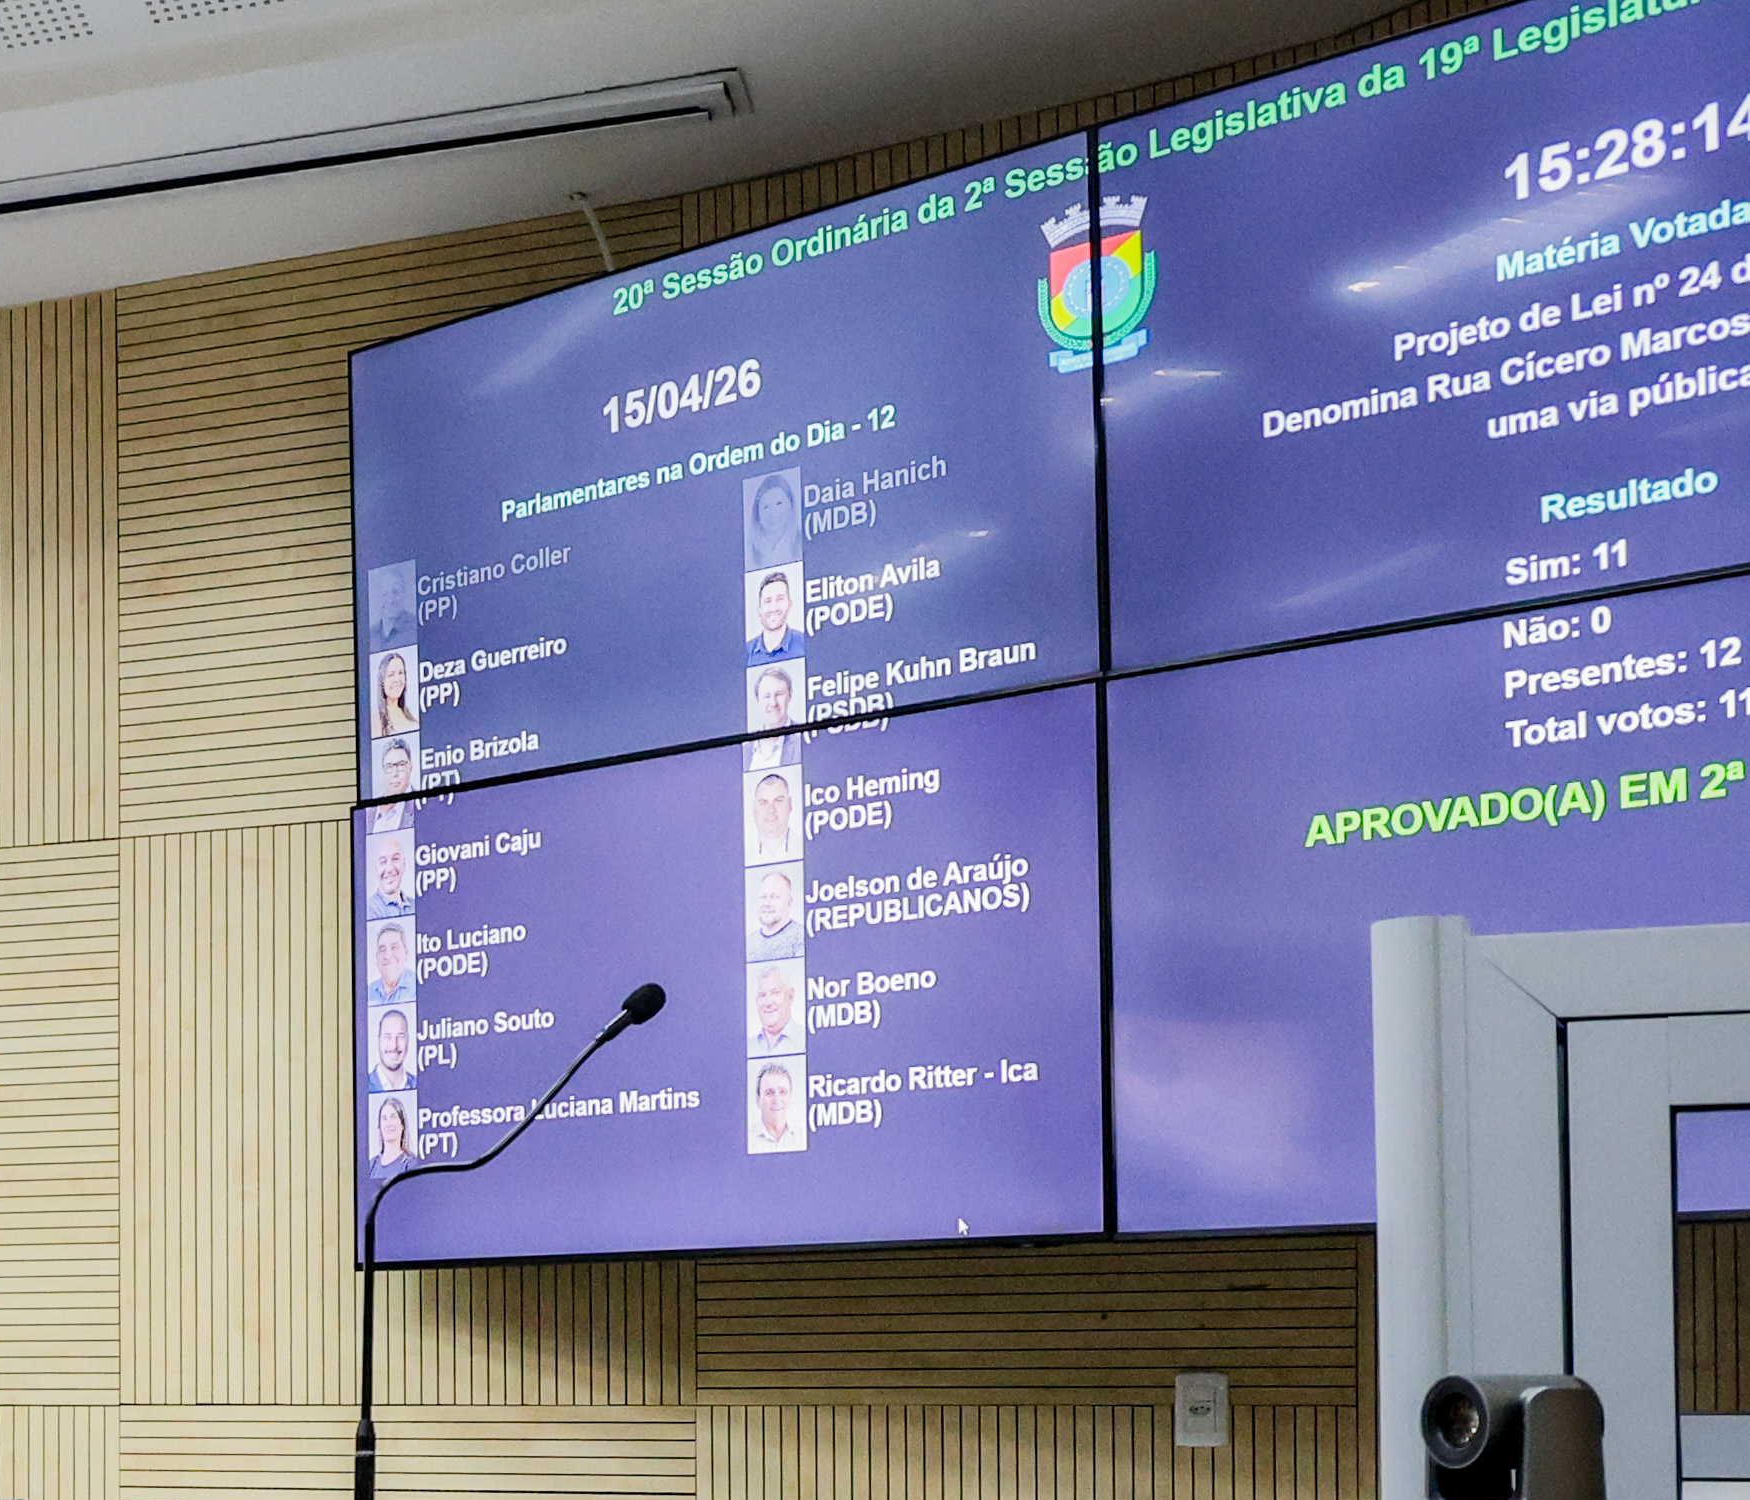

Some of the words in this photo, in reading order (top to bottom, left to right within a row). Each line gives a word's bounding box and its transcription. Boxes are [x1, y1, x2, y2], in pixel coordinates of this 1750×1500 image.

[1503, 92, 1750, 201] 15:28:14
[613, 278, 655, 316] 20ª
[662, 251, 764, 301] Sessão
[771, 207, 908, 268] Ordinária
[917, 189, 955, 226] da
[964, 175, 996, 213] 2ª
[1004, 141, 1139, 199] Sessão
[1148, 82, 1347, 158] Legislativa
[1358, 60, 1405, 101] da
[1418, 33, 1481, 81] 19ª
[1496, 229, 1621, 283] Matéria
[1630, 198, 1750, 246] Votada
[1394, 317, 1510, 362] Projeto
[1519, 302, 1562, 334] de
[1571, 284, 1622, 324] Lei
[1633, 273, 1670, 307] nº
[1678, 259, 1722, 298] 24
[602, 359, 762, 434] 15/04/26
[1262, 384, 1418, 438] Denomina
[1427, 369, 1491, 403] Rua
[1501, 341, 1612, 387] Cícero
[1620, 312, 1750, 361] Marcos
[1487, 405, 1559, 439] uma
[1567, 389, 1619, 425] via
[501, 470, 651, 523] Parlamentares
[656, 461, 684, 485] na
[689, 441, 765, 476] Ordem
[770, 431, 801, 457] do
[807, 417, 845, 449] Dia
[867, 404, 896, 432] 12
[804, 477, 855, 508] Daia
[862, 455, 947, 494] Hanich
[1540, 465, 1720, 524] Resultado
[804, 499, 876, 540] (MDB)
[417, 562, 506, 596] Cristiano
[511, 544, 572, 575] Coller
[806, 573, 874, 603] Eliton
[880, 556, 941, 588] Avila
[1505, 551, 1582, 587] Sim:
[1592, 538, 1629, 572] 11
[418, 595, 458, 626] (PP)
[806, 593, 893, 636] (PODE)
[1503, 613, 1581, 649] Não:
[1590, 605, 1613, 635] 0
[419, 656, 466, 683] Deza
[471, 634, 568, 672] Guerreiro
[807, 668, 879, 699] Felipe
[885, 656, 951, 686] Kuhn
[959, 641, 1037, 673] Braun
[1505, 649, 1688, 699] Presentes:
[1699, 636, 1742, 669] 12
[419, 680, 461, 712] (PP)
[1505, 710, 1588, 748] Total
[1597, 700, 1706, 736] votos:
[1719, 686, 1750, 719] 11
[421, 744, 465, 770] Enio
[470, 730, 540, 761] Brizola
[804, 782, 840, 808] Ico
[846, 768, 940, 801] Heming
[1304, 779, 1607, 848] APROVADO(A)
[1619, 767, 1688, 809] EM
[1700, 760, 1745, 799] 2ª
[804, 801, 892, 840] (PODE)
[415, 835, 490, 867] Giovani
[495, 828, 541, 855] Caju
[415, 867, 457, 896] (PP)
[805, 866, 900, 904] Joelson
[906, 865, 938, 890] de
[943, 853, 1029, 887] Araújo
[806, 882, 1030, 938] (REPUBLICANOS)
[416, 932, 442, 955] Ito
[447, 923, 527, 950] Luciano
[416, 952, 489, 985] (PODE)
[807, 976, 851, 1001] Nor
[856, 969, 937, 995] Boeno
[417, 1016, 489, 1041] Juliano
[494, 1008, 555, 1034] Souto
[807, 1000, 881, 1034] (MDB)
[417, 1042, 458, 1071] (PL)
[808, 1070, 901, 1098] Ricardo
[909, 1064, 978, 1090] Ritter
[1000, 1059, 1039, 1084] Ica
[418, 1102, 525, 1129] Professora
[619, 1086, 700, 1113] Martins
[808, 1099, 882, 1132] (MDB)
[418, 1131, 459, 1160] (PT)
